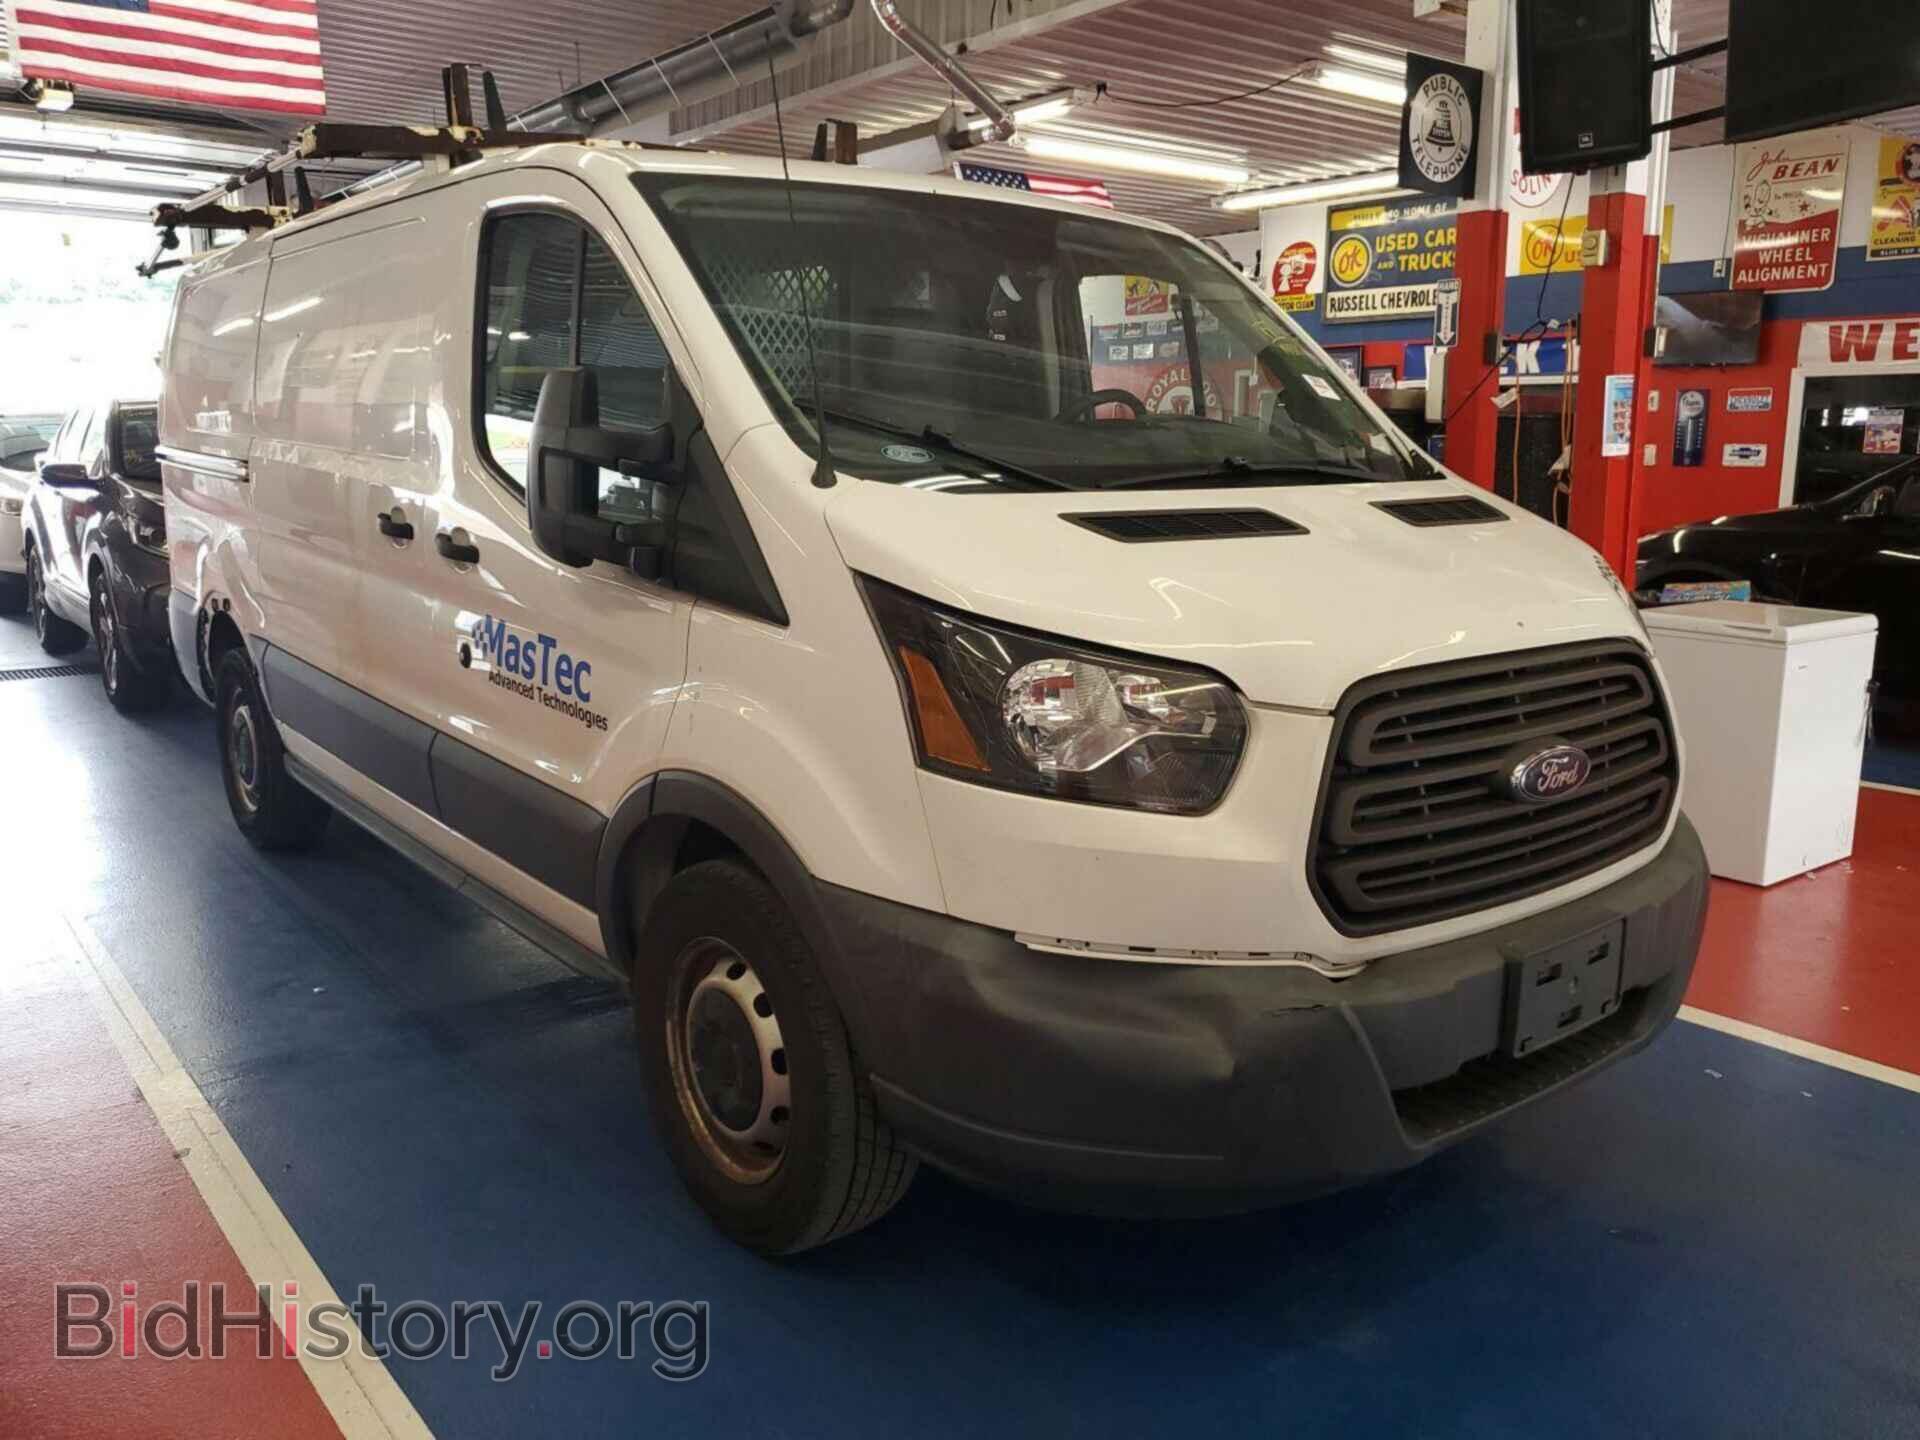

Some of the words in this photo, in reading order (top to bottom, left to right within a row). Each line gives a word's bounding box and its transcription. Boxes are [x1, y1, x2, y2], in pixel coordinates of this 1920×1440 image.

[1422, 76, 1466, 106] PUBLIC
[1412, 133, 1467, 179] TELEPHONE
[1747, 150, 1790, 181] John
[1772, 158, 1840, 180] BEAN
[1375, 232, 1419, 254] USED
[1758, 247, 1814, 264] WHEEL
[1338, 245, 1363, 274] OK
[1377, 261, 1394, 270] AND
[1736, 263, 1830, 284] ALIGNMENT
[1329, 294, 1378, 313] RUSSELL
[1145, 368, 1191, 412] ROYAL
[485, 614, 592, 703] MasTec
[488, 671, 535, 701] Advanced
[536, 686, 609, 731] Technologies
[1537, 756, 1580, 792] Ford
